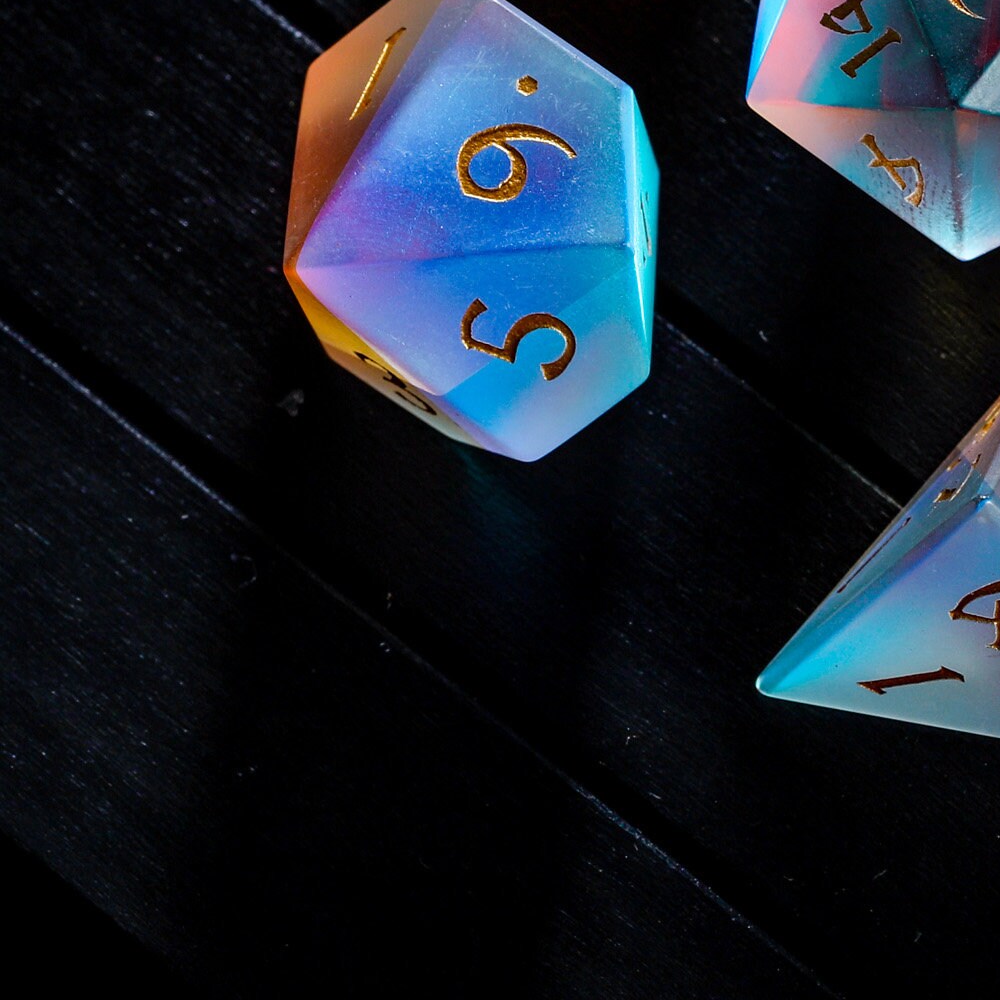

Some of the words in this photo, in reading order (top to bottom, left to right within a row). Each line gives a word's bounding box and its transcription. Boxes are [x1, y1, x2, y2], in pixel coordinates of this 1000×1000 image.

[349, 26, 406, 121] 1
[858, 133, 925, 208] 4
[460, 297, 577, 381] 5
[353, 351, 437, 416] 3
[857, 666, 965, 694] 1
